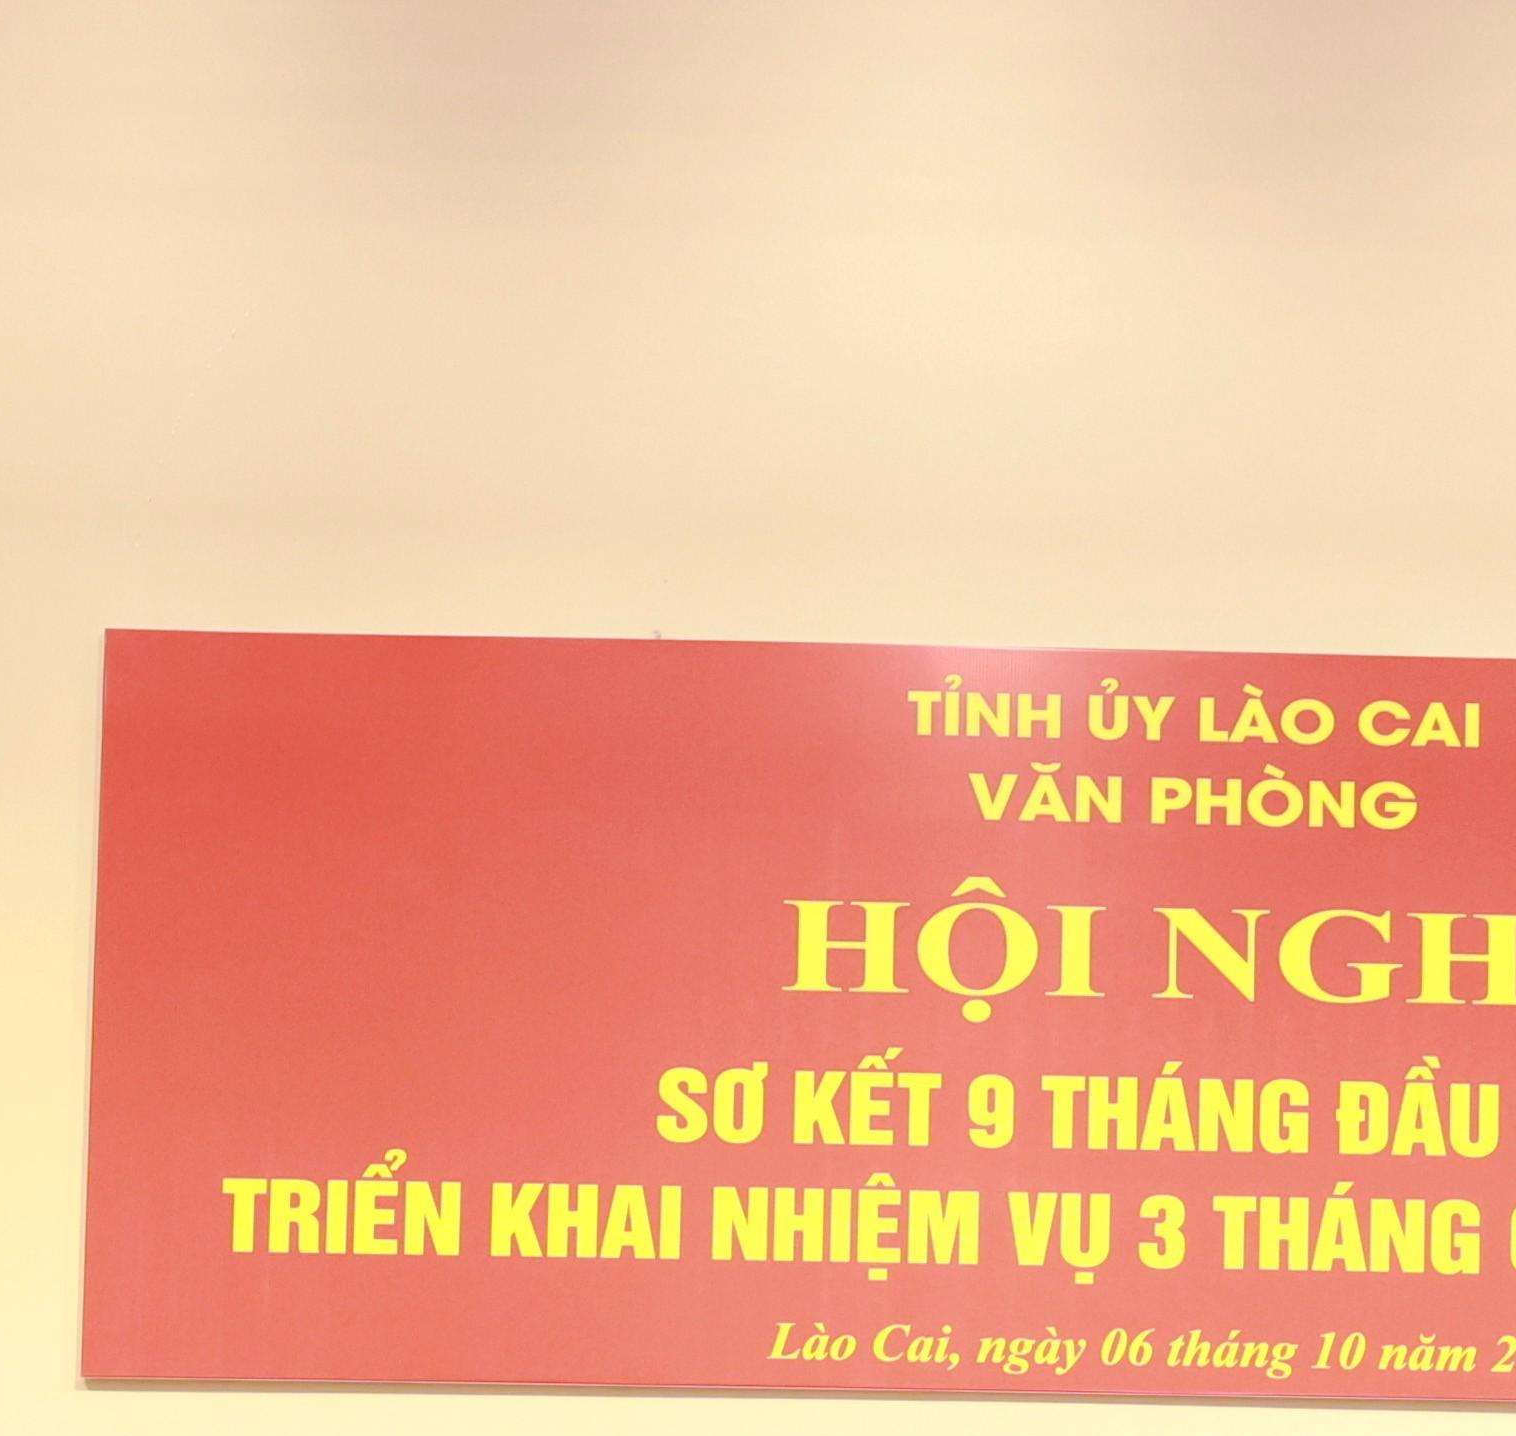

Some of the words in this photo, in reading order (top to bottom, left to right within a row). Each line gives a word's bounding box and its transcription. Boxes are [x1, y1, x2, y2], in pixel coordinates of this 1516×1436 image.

[907, 674, 1063, 740] TỈNH
[1088, 677, 1175, 741] ỦY
[1199, 684, 1335, 745] LÀO
[1358, 700, 1480, 748] CAI
[968, 761, 1123, 823] VĂN
[1151, 764, 1417, 830] PHÒNG
[784, 876, 1106, 1023] HỘI
[656, 1061, 769, 1145] SƠ
[793, 1046, 943, 1147] KẾT
[967, 1074, 1017, 1149] 9
[1041, 1061, 1310, 1155] THÁNG
[1335, 1055, 1500, 1159] ĐẦU
[222, 1148, 462, 1256] TRIỂN
[490, 1182, 682, 1260] KHAI
[711, 1172, 982, 1281] NHIỆM
[1006, 1190, 1114, 1285] VỤ
[1138, 1194, 1188, 1270] 3
[1212, 1181, 1483, 1276] THÁNG
[768, 1322, 859, 1361] Lào
[872, 1323, 962, 1367] Cai,
[976, 1327, 1088, 1376] ngày
[1100, 1328, 1155, 1366] 06
[1166, 1329, 1299, 1380] tháng
[1312, 1332, 1369, 1371] 10
[1377, 1335, 1478, 1373] năm
